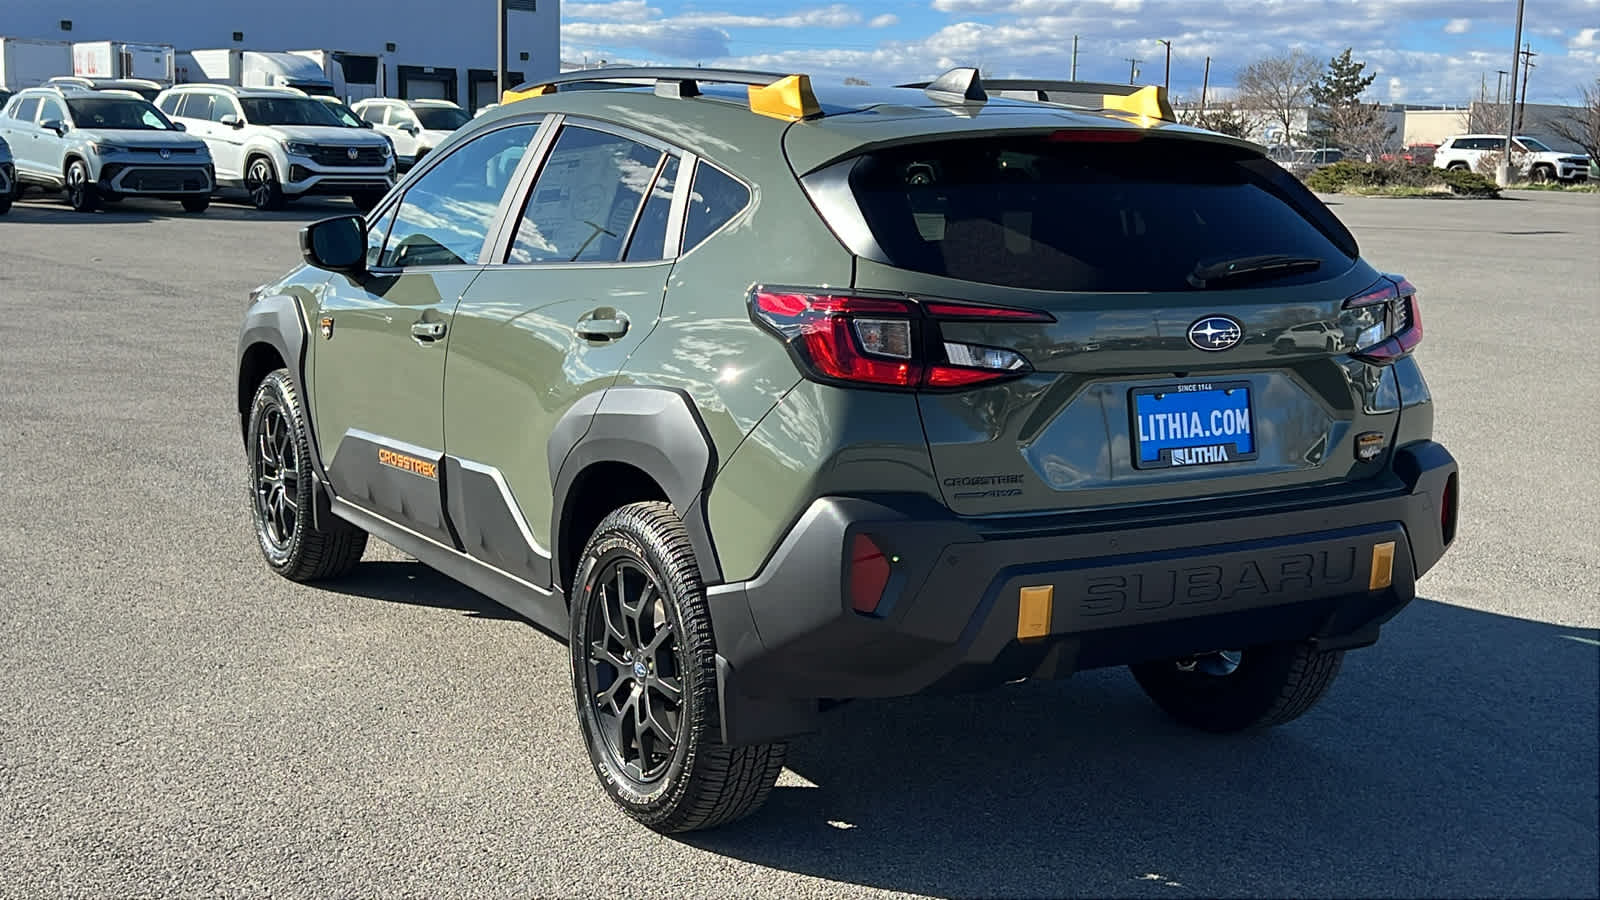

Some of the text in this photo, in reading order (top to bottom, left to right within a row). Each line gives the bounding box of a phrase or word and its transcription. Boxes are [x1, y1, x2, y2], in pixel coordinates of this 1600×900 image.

[1177, 384, 1197, 393] SINCE
[1138, 408, 1250, 442] LITHIA.COM
[378, 449, 436, 478] CROSSTREK
[1184, 445, 1228, 466] LITHIA
[1080, 547, 1357, 617] SUBARU
